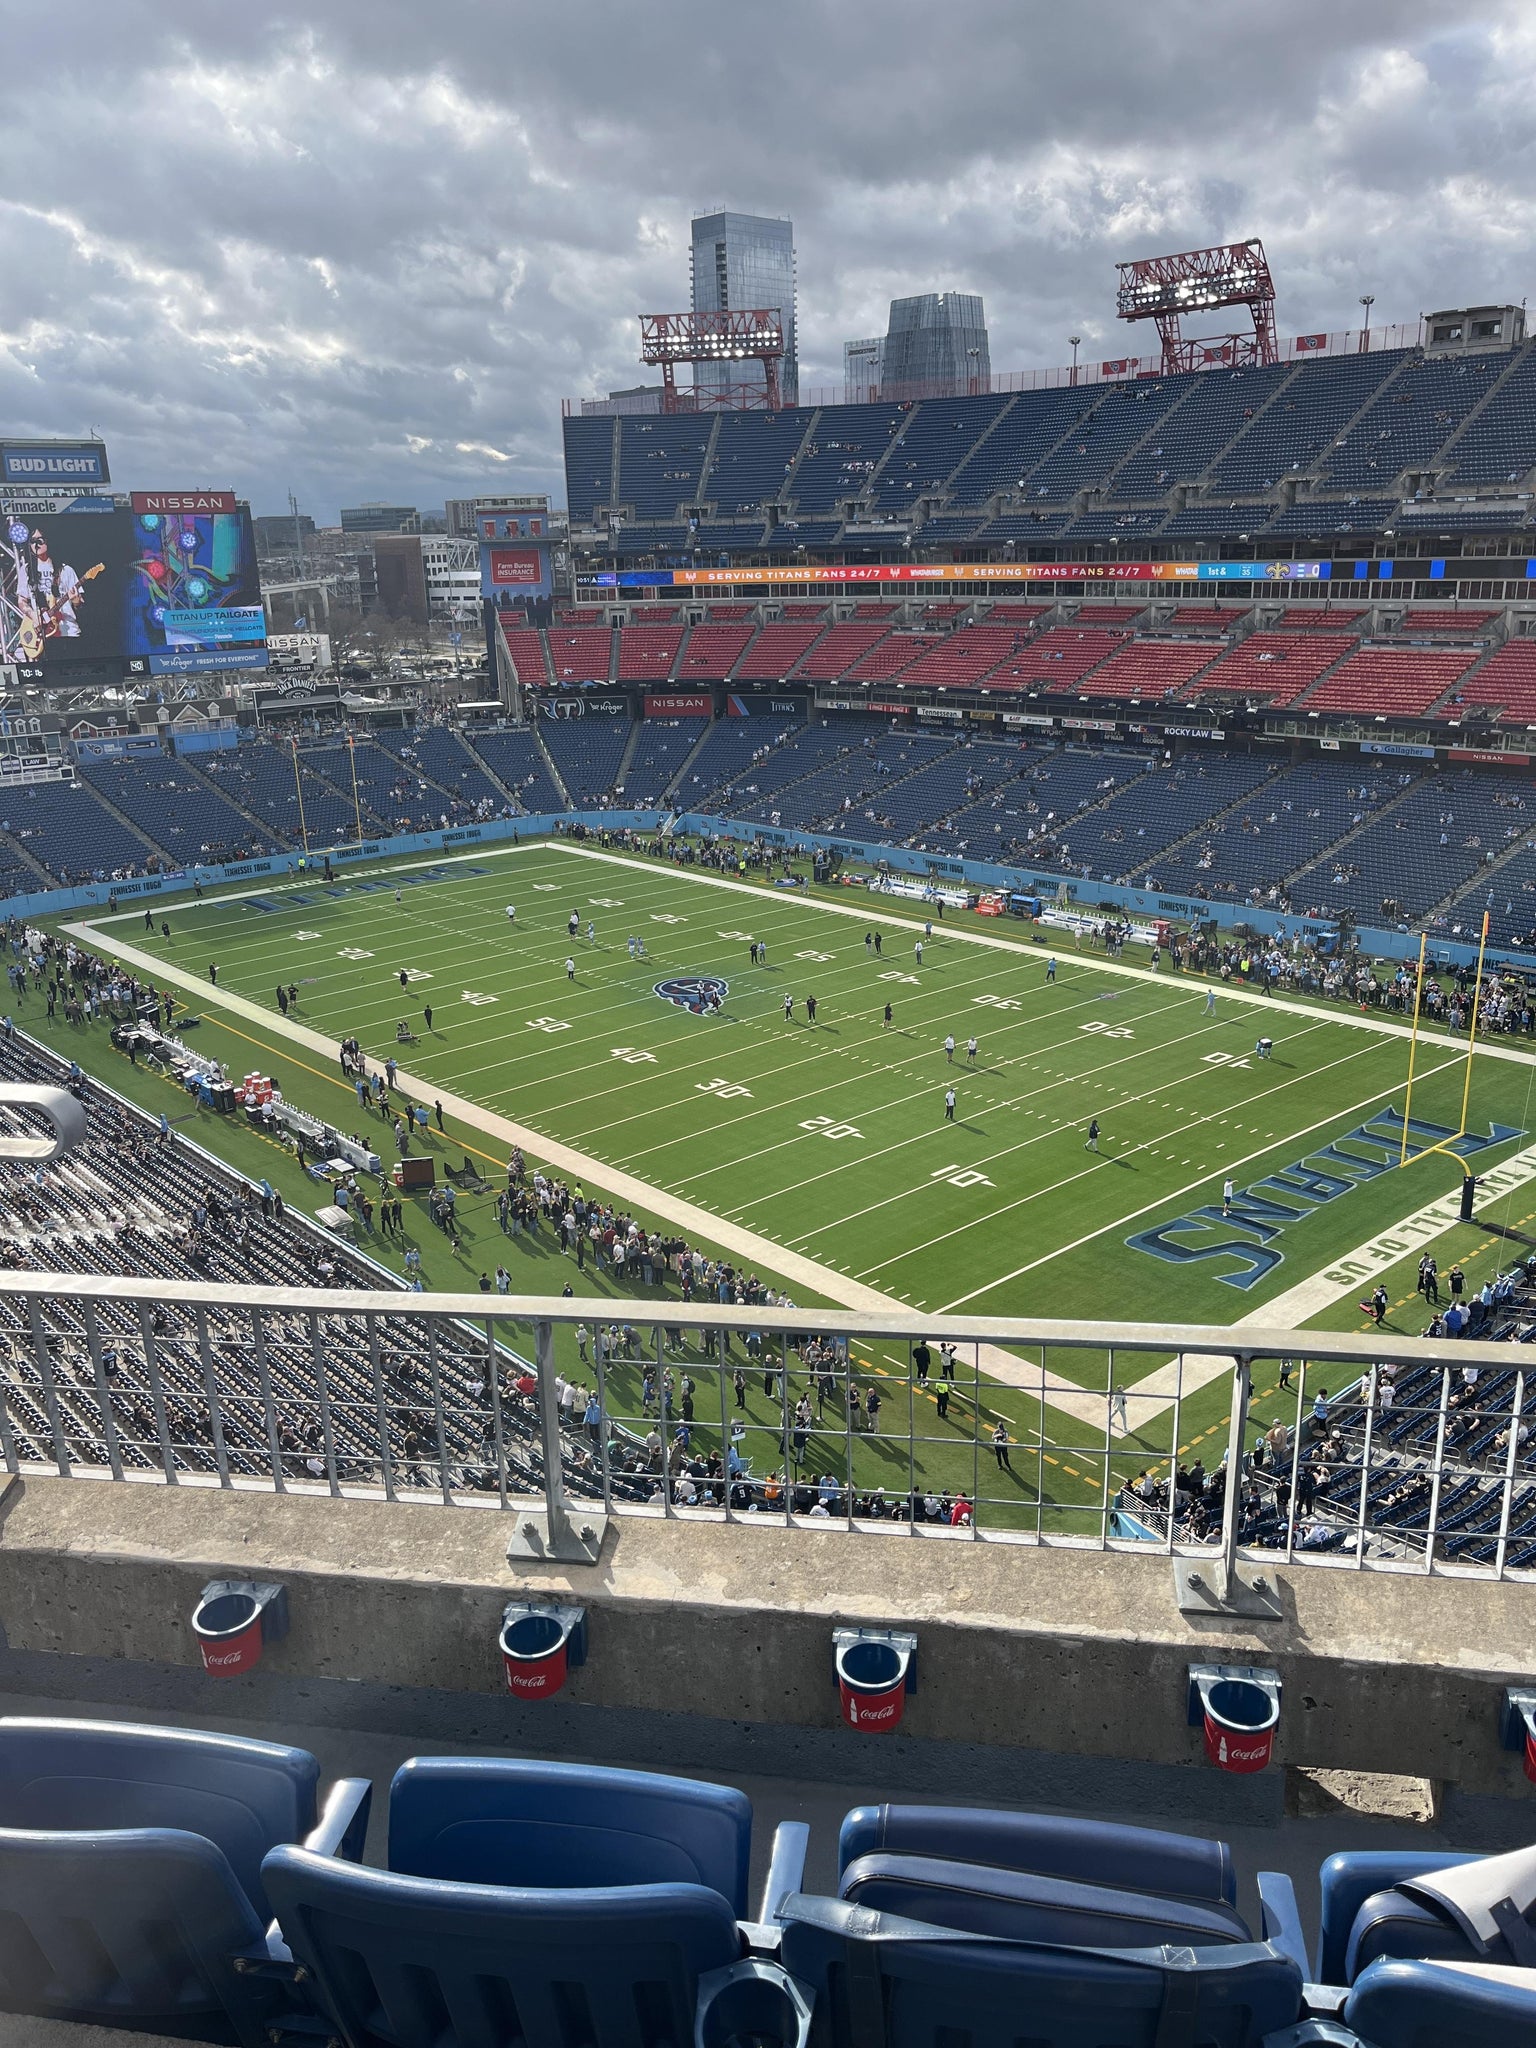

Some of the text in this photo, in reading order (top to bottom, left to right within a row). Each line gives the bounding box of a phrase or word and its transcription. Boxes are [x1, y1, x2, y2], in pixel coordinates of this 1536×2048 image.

[9, 458, 96, 472] BUD LIGHT
[2, 500, 56, 513] Pinnacle
[146, 497, 223, 508] NISSAN
[850, 569, 880, 578] 24/7
[1072, 568, 1104, 576] FANS
[1108, 567, 1140, 576] 24/7
[1208, 567, 1226, 576] 1st &
[172, 613, 198, 622] TITAN
[215, 610, 259, 620] TAILGATE
[266, 636, 320, 648] NISSAN
[170, 656, 192, 670] Kroger
[278, 681, 293, 695] JACK
[600, 701, 624, 714] Kroger
[652, 699, 704, 707] NISSAN
[770, 702, 795, 712] TITANS
[922, 708, 958, 717] Tennessean
[1164, 728, 1190, 736] ROCKY
[1384, 746, 1424, 756] Gallagher
[442, 829, 481, 842] TENNESSEE TOUGH
[336, 845, 379, 858] TENNESSEE TOUGH
[224, 862, 271, 877] TENNESSEE TOUGH
[924, 860, 964, 874] TENNESSEE TOUGH
[110, 882, 162, 896] TENNESSEE TOUGH
[588, 898, 626, 908] 20
[650, 914, 689, 924] 30
[717, 931, 754, 941] 40
[336, 947, 376, 960] 20
[793, 950, 836, 963] 50
[876, 971, 918, 985] 40
[460, 990, 500, 1006] 40
[970, 994, 1022, 1010] 30
[526, 1016, 574, 1032] 50
[1078, 1021, 1134, 1038] 20
[610, 1047, 655, 1064] 40
[1200, 1052, 1247, 1068] 10
[694, 1078, 749, 1099] 30
[798, 1116, 858, 1140] 20
[930, 1164, 985, 1188] 10
[1124, 1104, 1530, 1292] TITANS
[1398, 1208, 1456, 1236] ALL
[1367, 1238, 1410, 1262] OF
[1324, 1261, 1374, 1286] US
[208, 1650, 242, 1666] Coca-Cola
[513, 1674, 546, 1688] Coca-Cola
[860, 1704, 895, 1720] Coca-Cola
[1231, 1744, 1268, 1760] Coca-Cola
